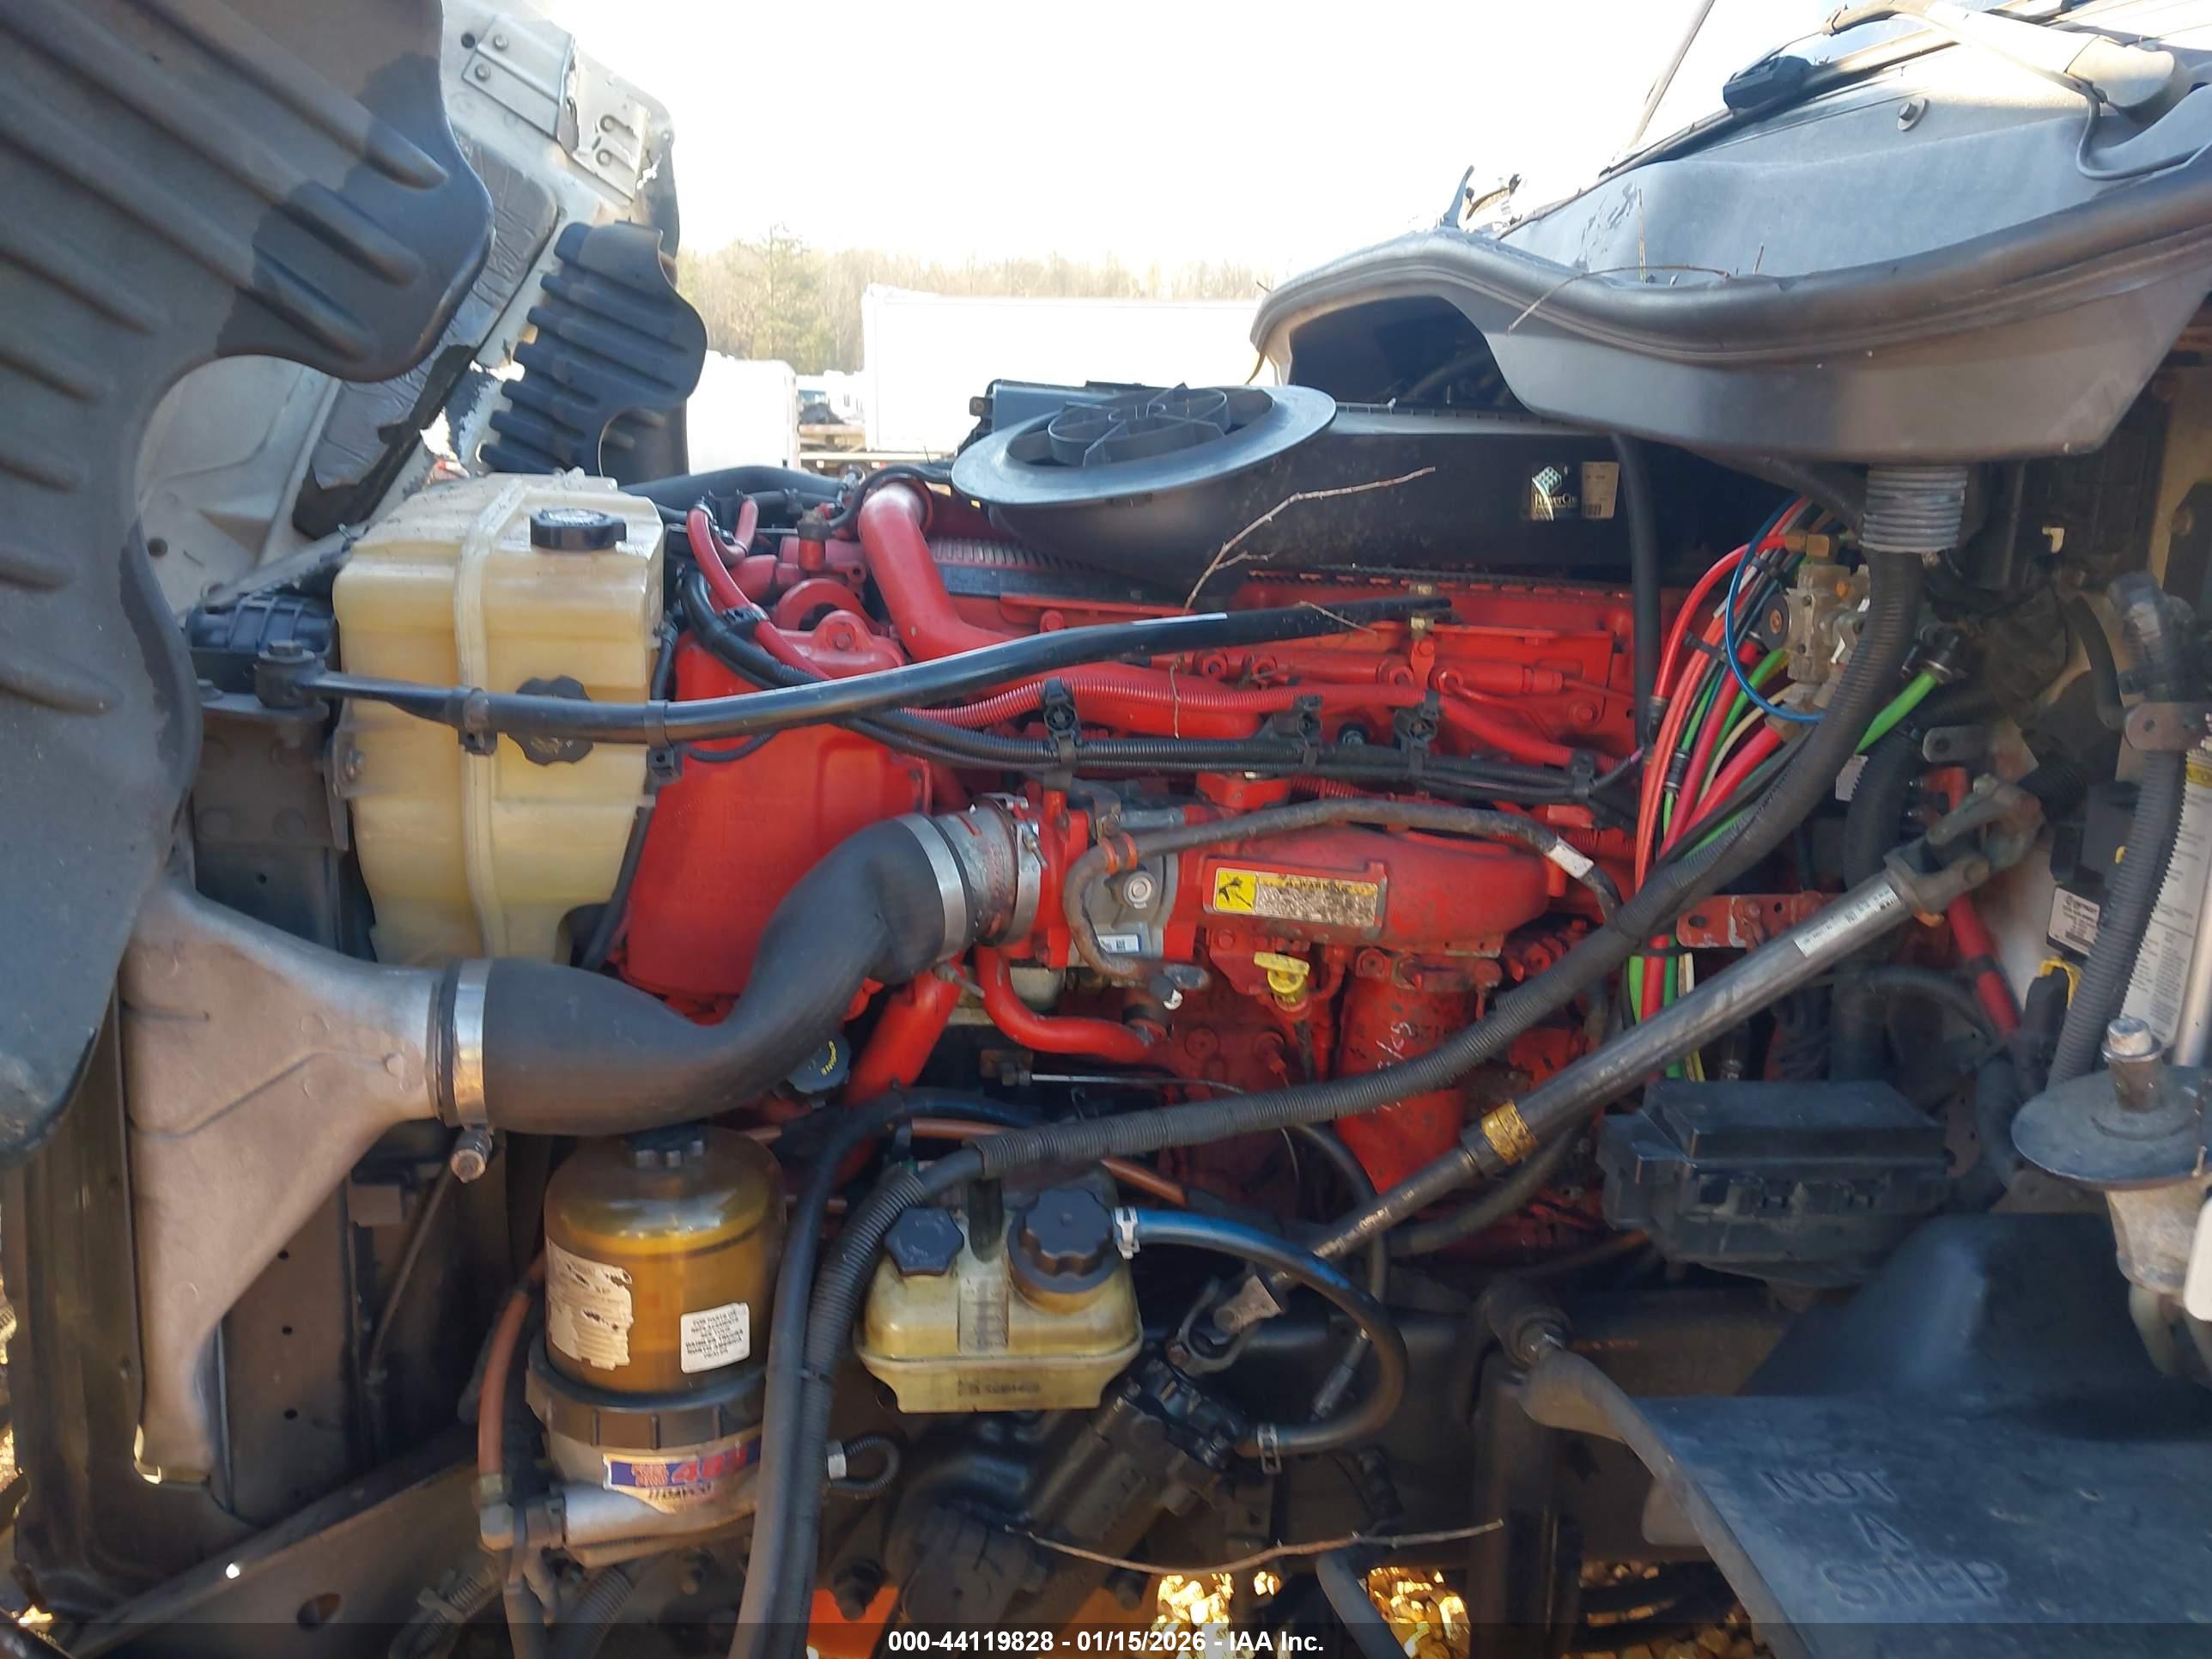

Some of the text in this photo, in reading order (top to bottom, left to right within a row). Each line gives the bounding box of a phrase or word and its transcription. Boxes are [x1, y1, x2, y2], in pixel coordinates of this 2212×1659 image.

[1759, 1468, 1897, 1504] NOT
[1851, 1512, 1911, 1551] A
[1819, 1559, 2008, 1608] STEP
